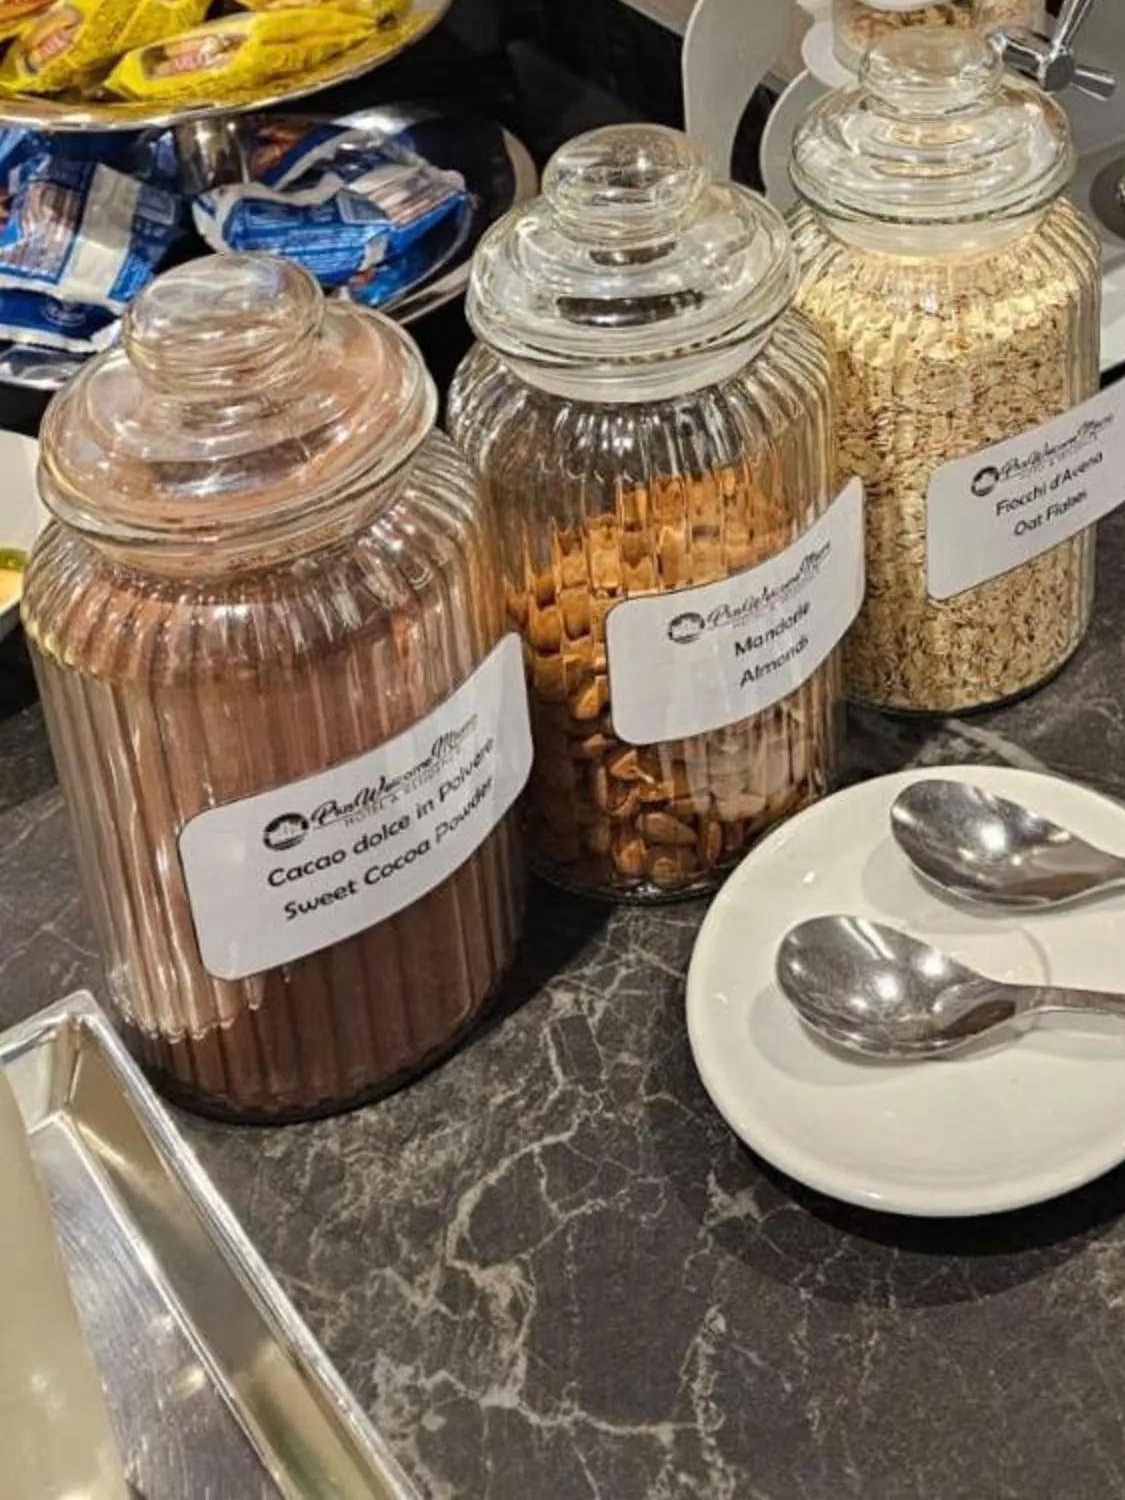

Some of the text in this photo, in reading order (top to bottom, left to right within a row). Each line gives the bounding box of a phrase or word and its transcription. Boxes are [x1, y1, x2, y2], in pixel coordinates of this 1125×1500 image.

[995, 482, 1047, 517] Fiocchi
[1013, 489, 1088, 537] Oat Flakes
[740, 635, 809, 688] Almonds
[267, 850, 347, 887] Cacao
[352, 815, 411, 855] dolce
[416, 799, 436, 822] in
[438, 737, 495, 803] Polvere
[283, 775, 494, 921] Sweet Cocoa Powder
